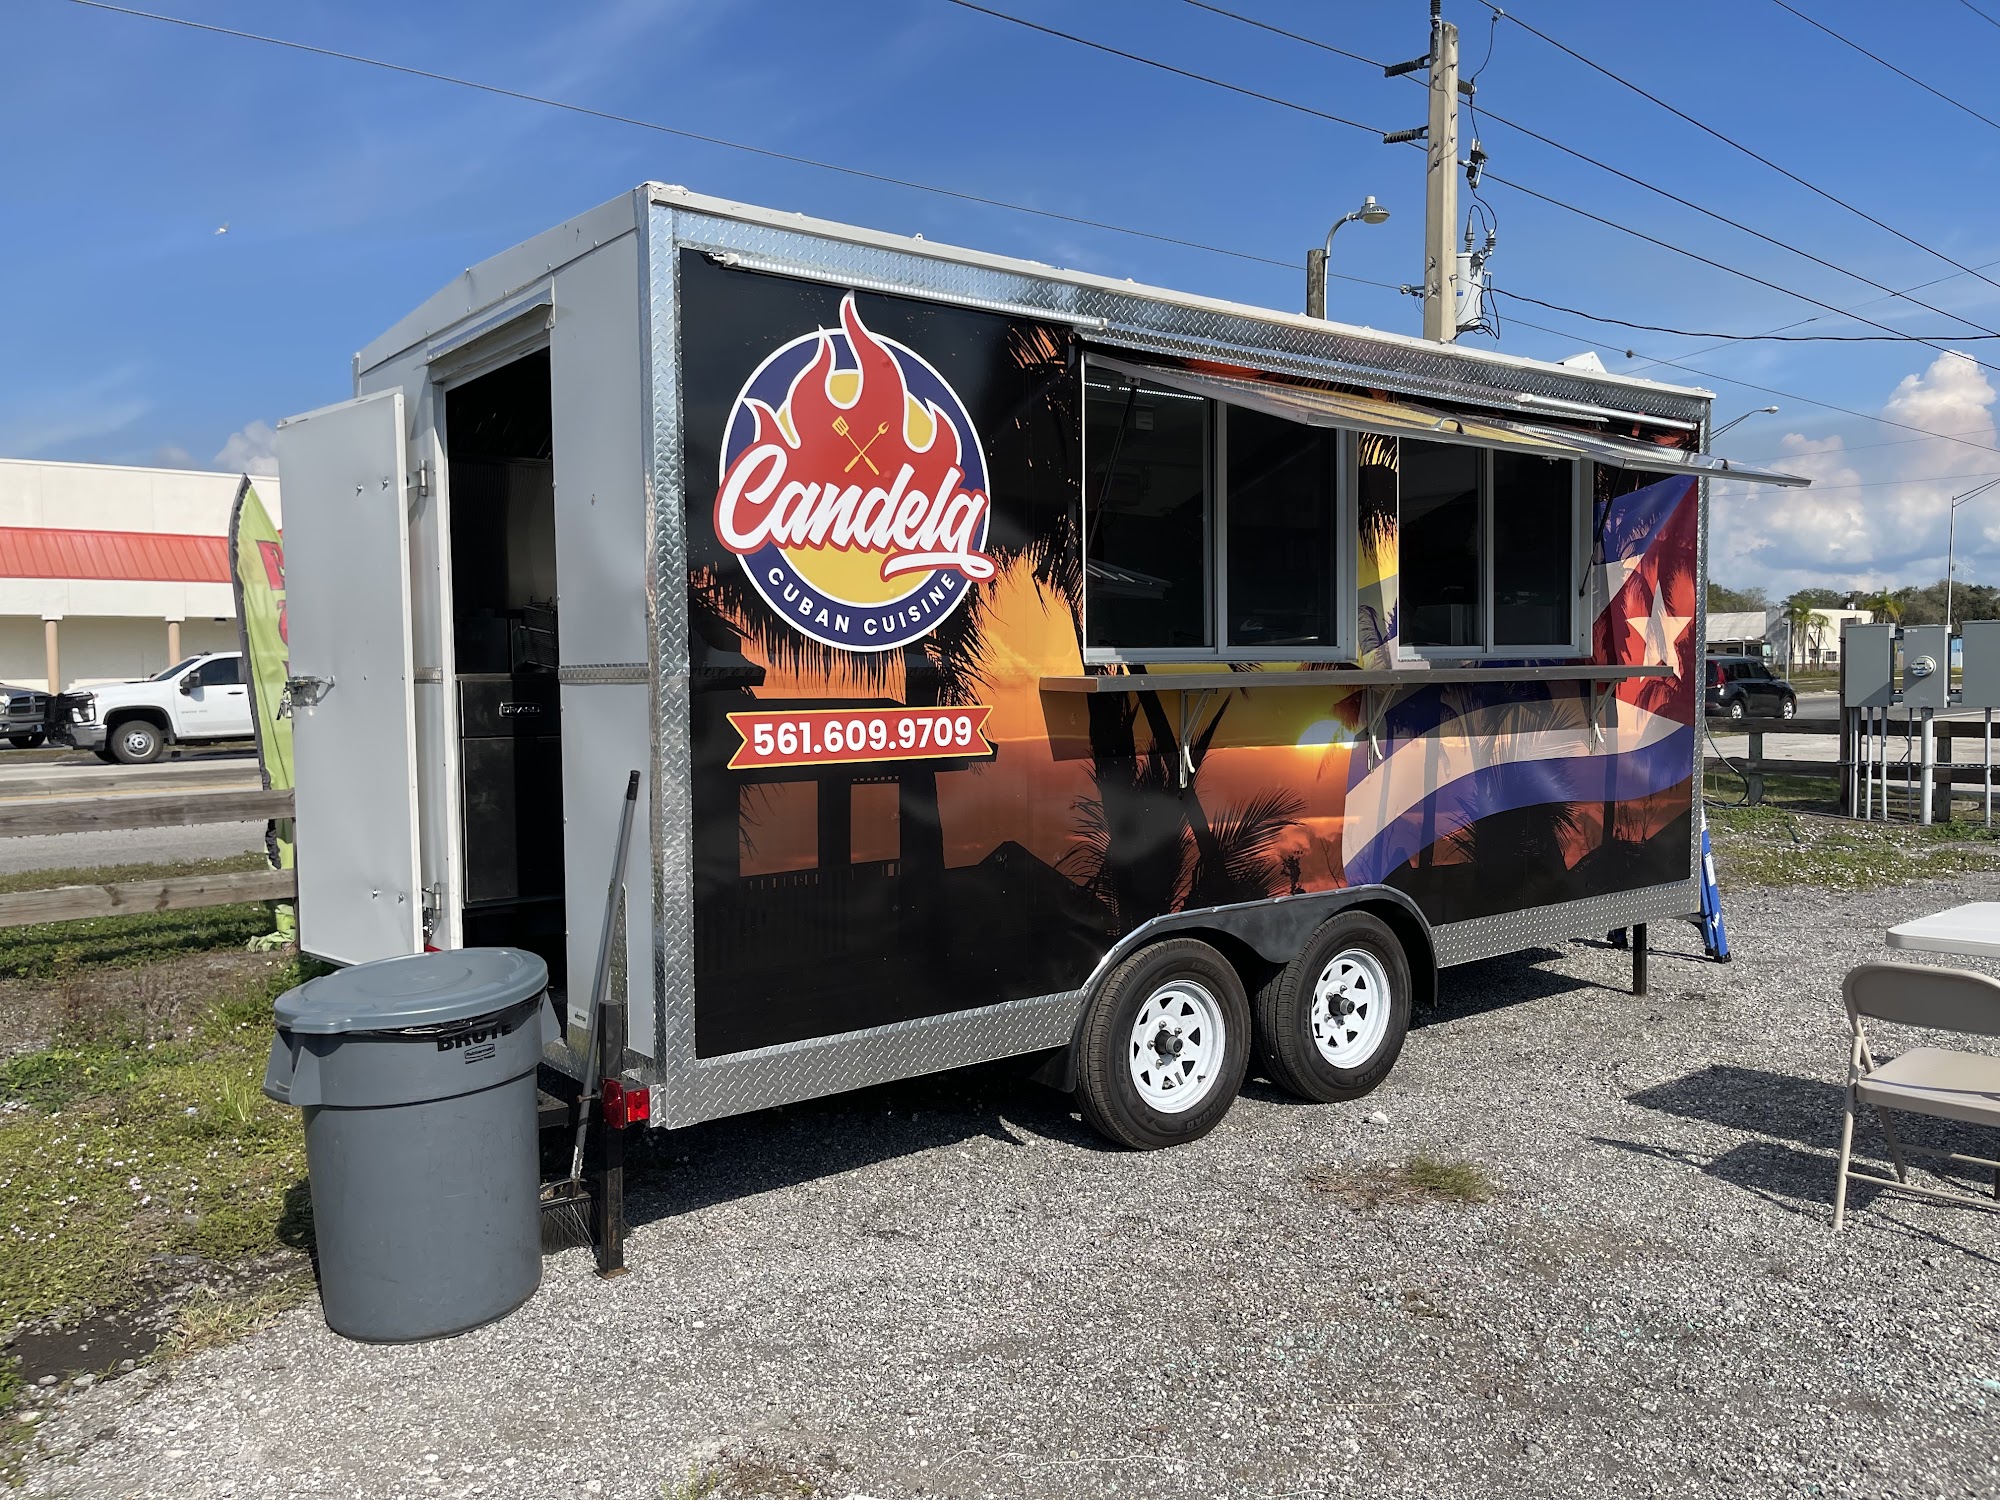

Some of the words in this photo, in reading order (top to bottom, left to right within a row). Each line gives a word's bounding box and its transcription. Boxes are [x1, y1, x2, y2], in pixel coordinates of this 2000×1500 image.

[717, 444, 995, 579] Candela
[768, 567, 850, 633] CUBAN
[864, 573, 956, 635] CUISINE
[754, 716, 972, 756] 561.609.9709
